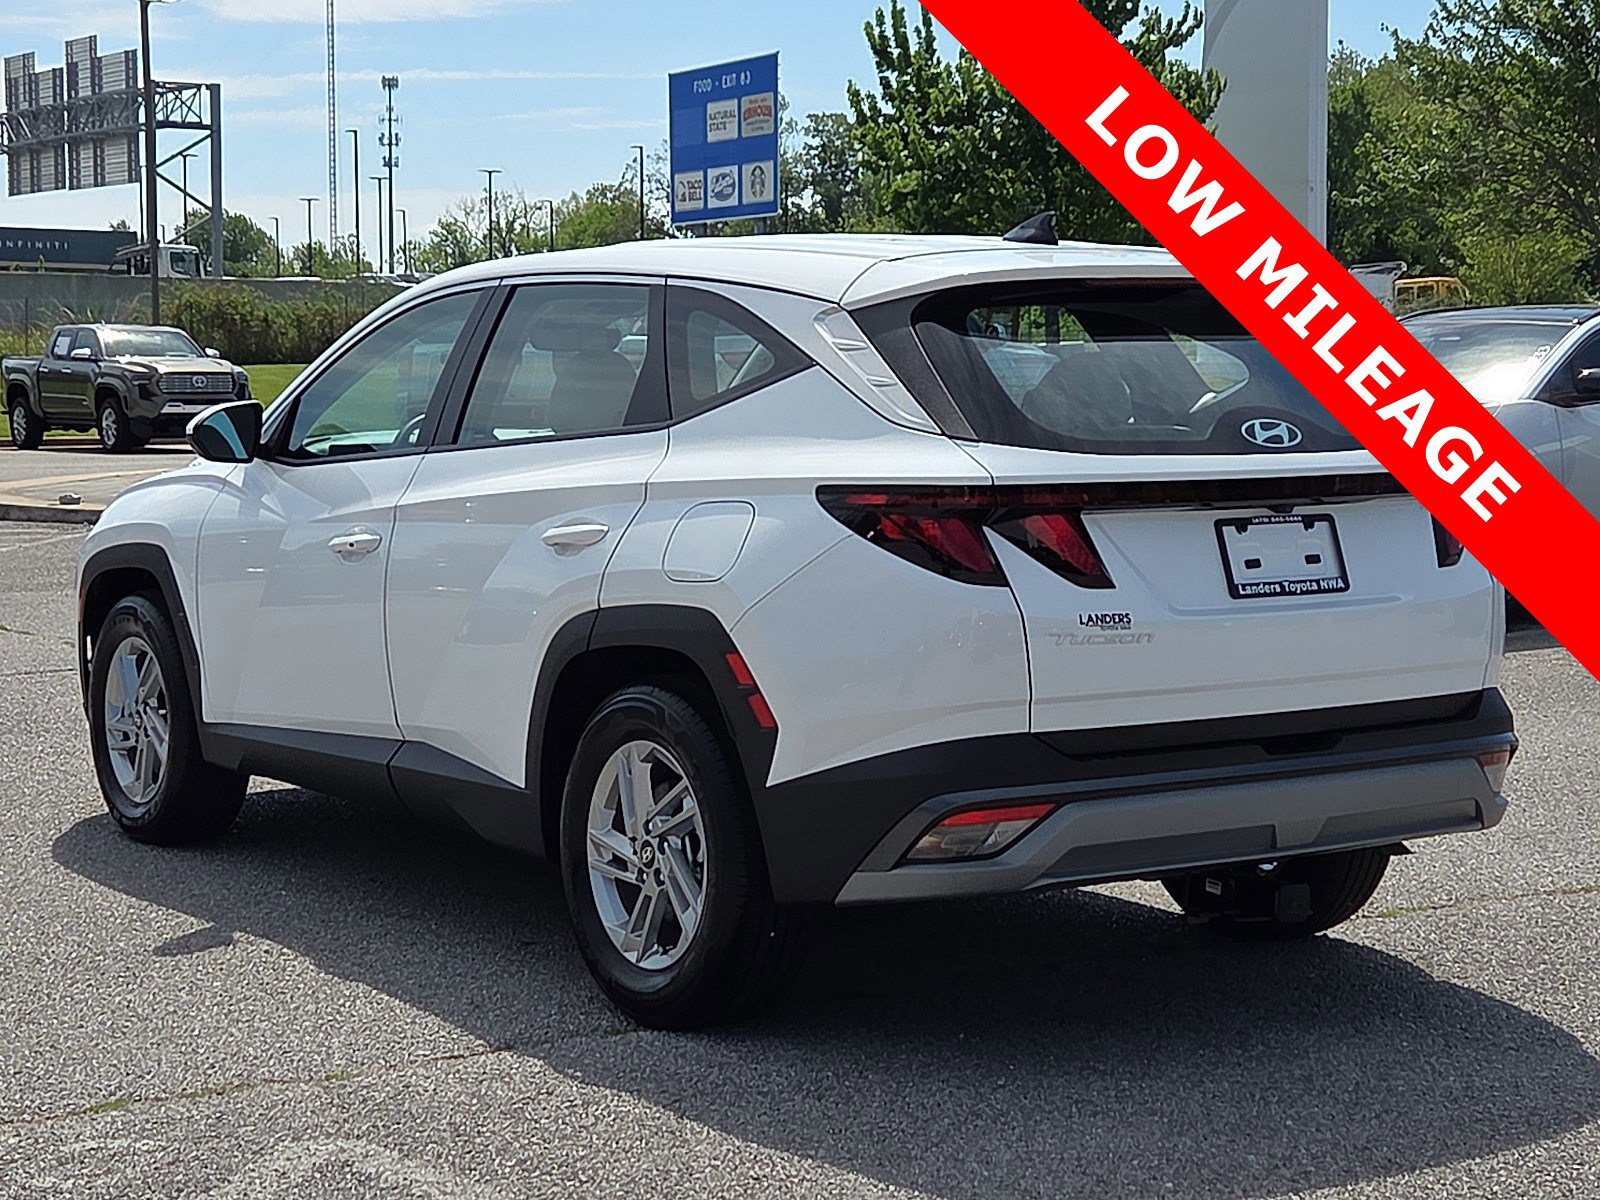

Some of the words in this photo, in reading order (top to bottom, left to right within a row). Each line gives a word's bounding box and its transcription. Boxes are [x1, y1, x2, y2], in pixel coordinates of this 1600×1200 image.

[694, 79, 712, 93] FOOD
[722, 73, 736, 88] EXIT
[709, 109, 736, 120] NATURAL
[709, 121, 727, 132] STATE
[687, 178, 702, 190] TACO
[688, 190, 702, 202] BELL
[1238, 583, 1281, 595] Landers
[1282, 581, 1318, 594] Toyota
[1320, 578, 1345, 590] NWA
[1079, 612, 1132, 626] LANDERS
